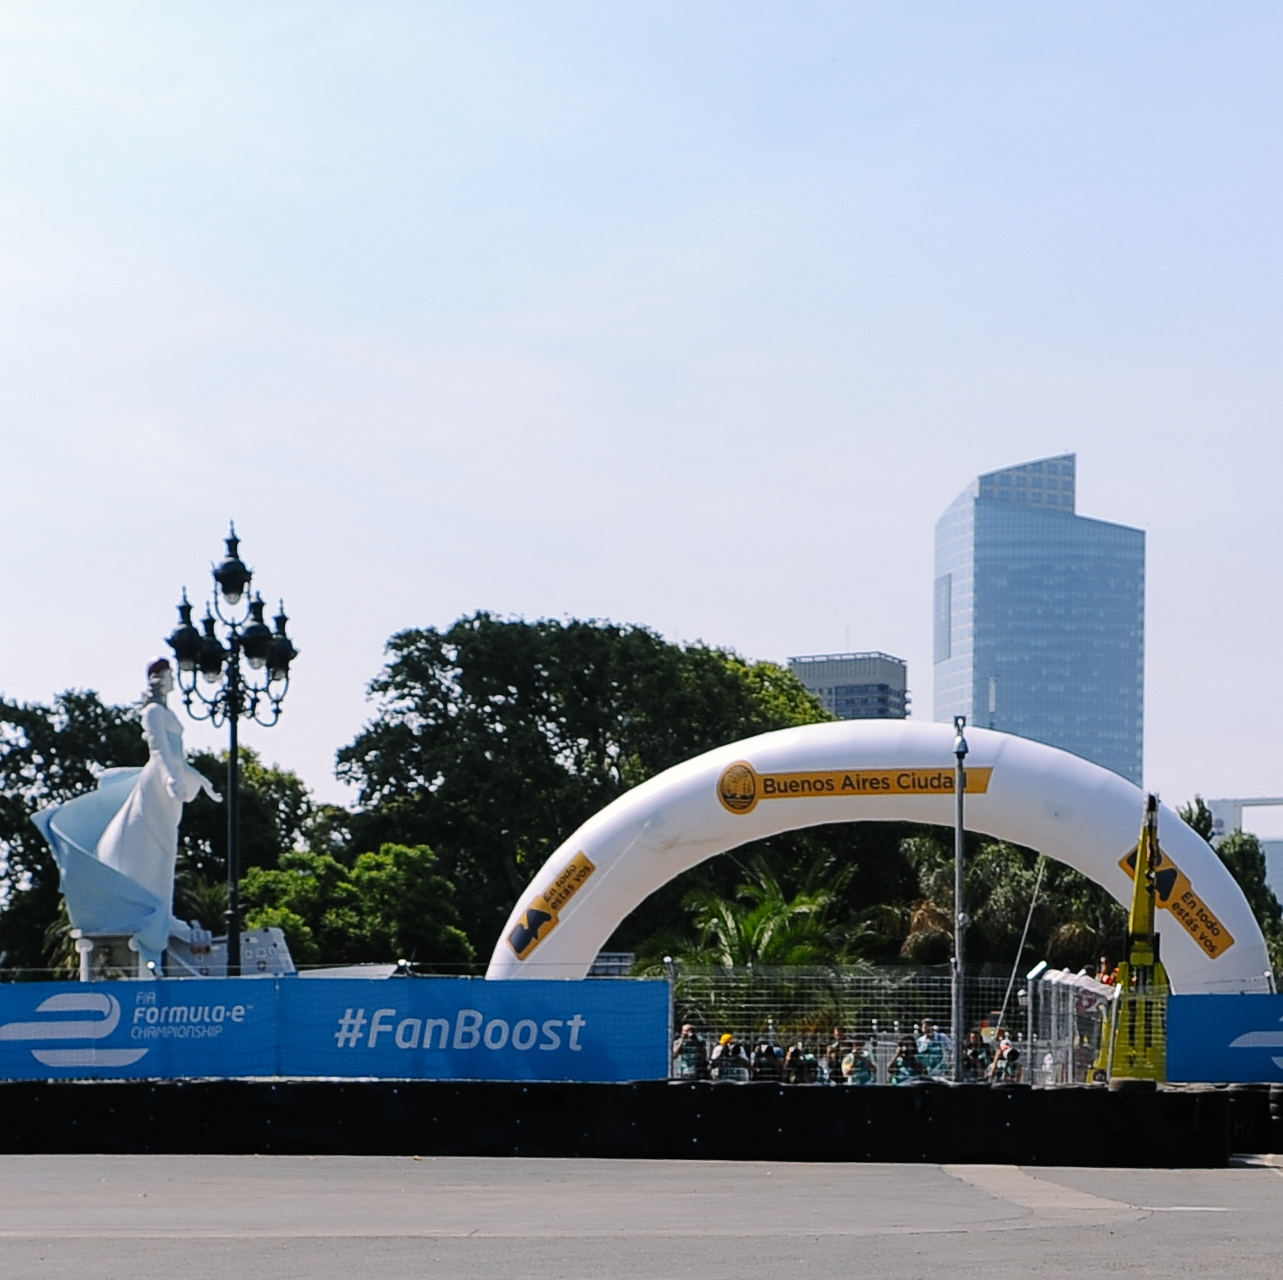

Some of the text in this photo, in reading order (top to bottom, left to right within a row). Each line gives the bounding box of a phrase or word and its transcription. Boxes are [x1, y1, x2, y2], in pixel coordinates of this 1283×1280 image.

[763, 777, 835, 795] Buenos
[841, 774, 890, 792] Aires
[1171, 901, 1217, 953] estás vos
[1180, 891, 1221, 937] En todo
[135, 991, 157, 1005] FIA
[334, 1008, 586, 1051] #FanBoost
